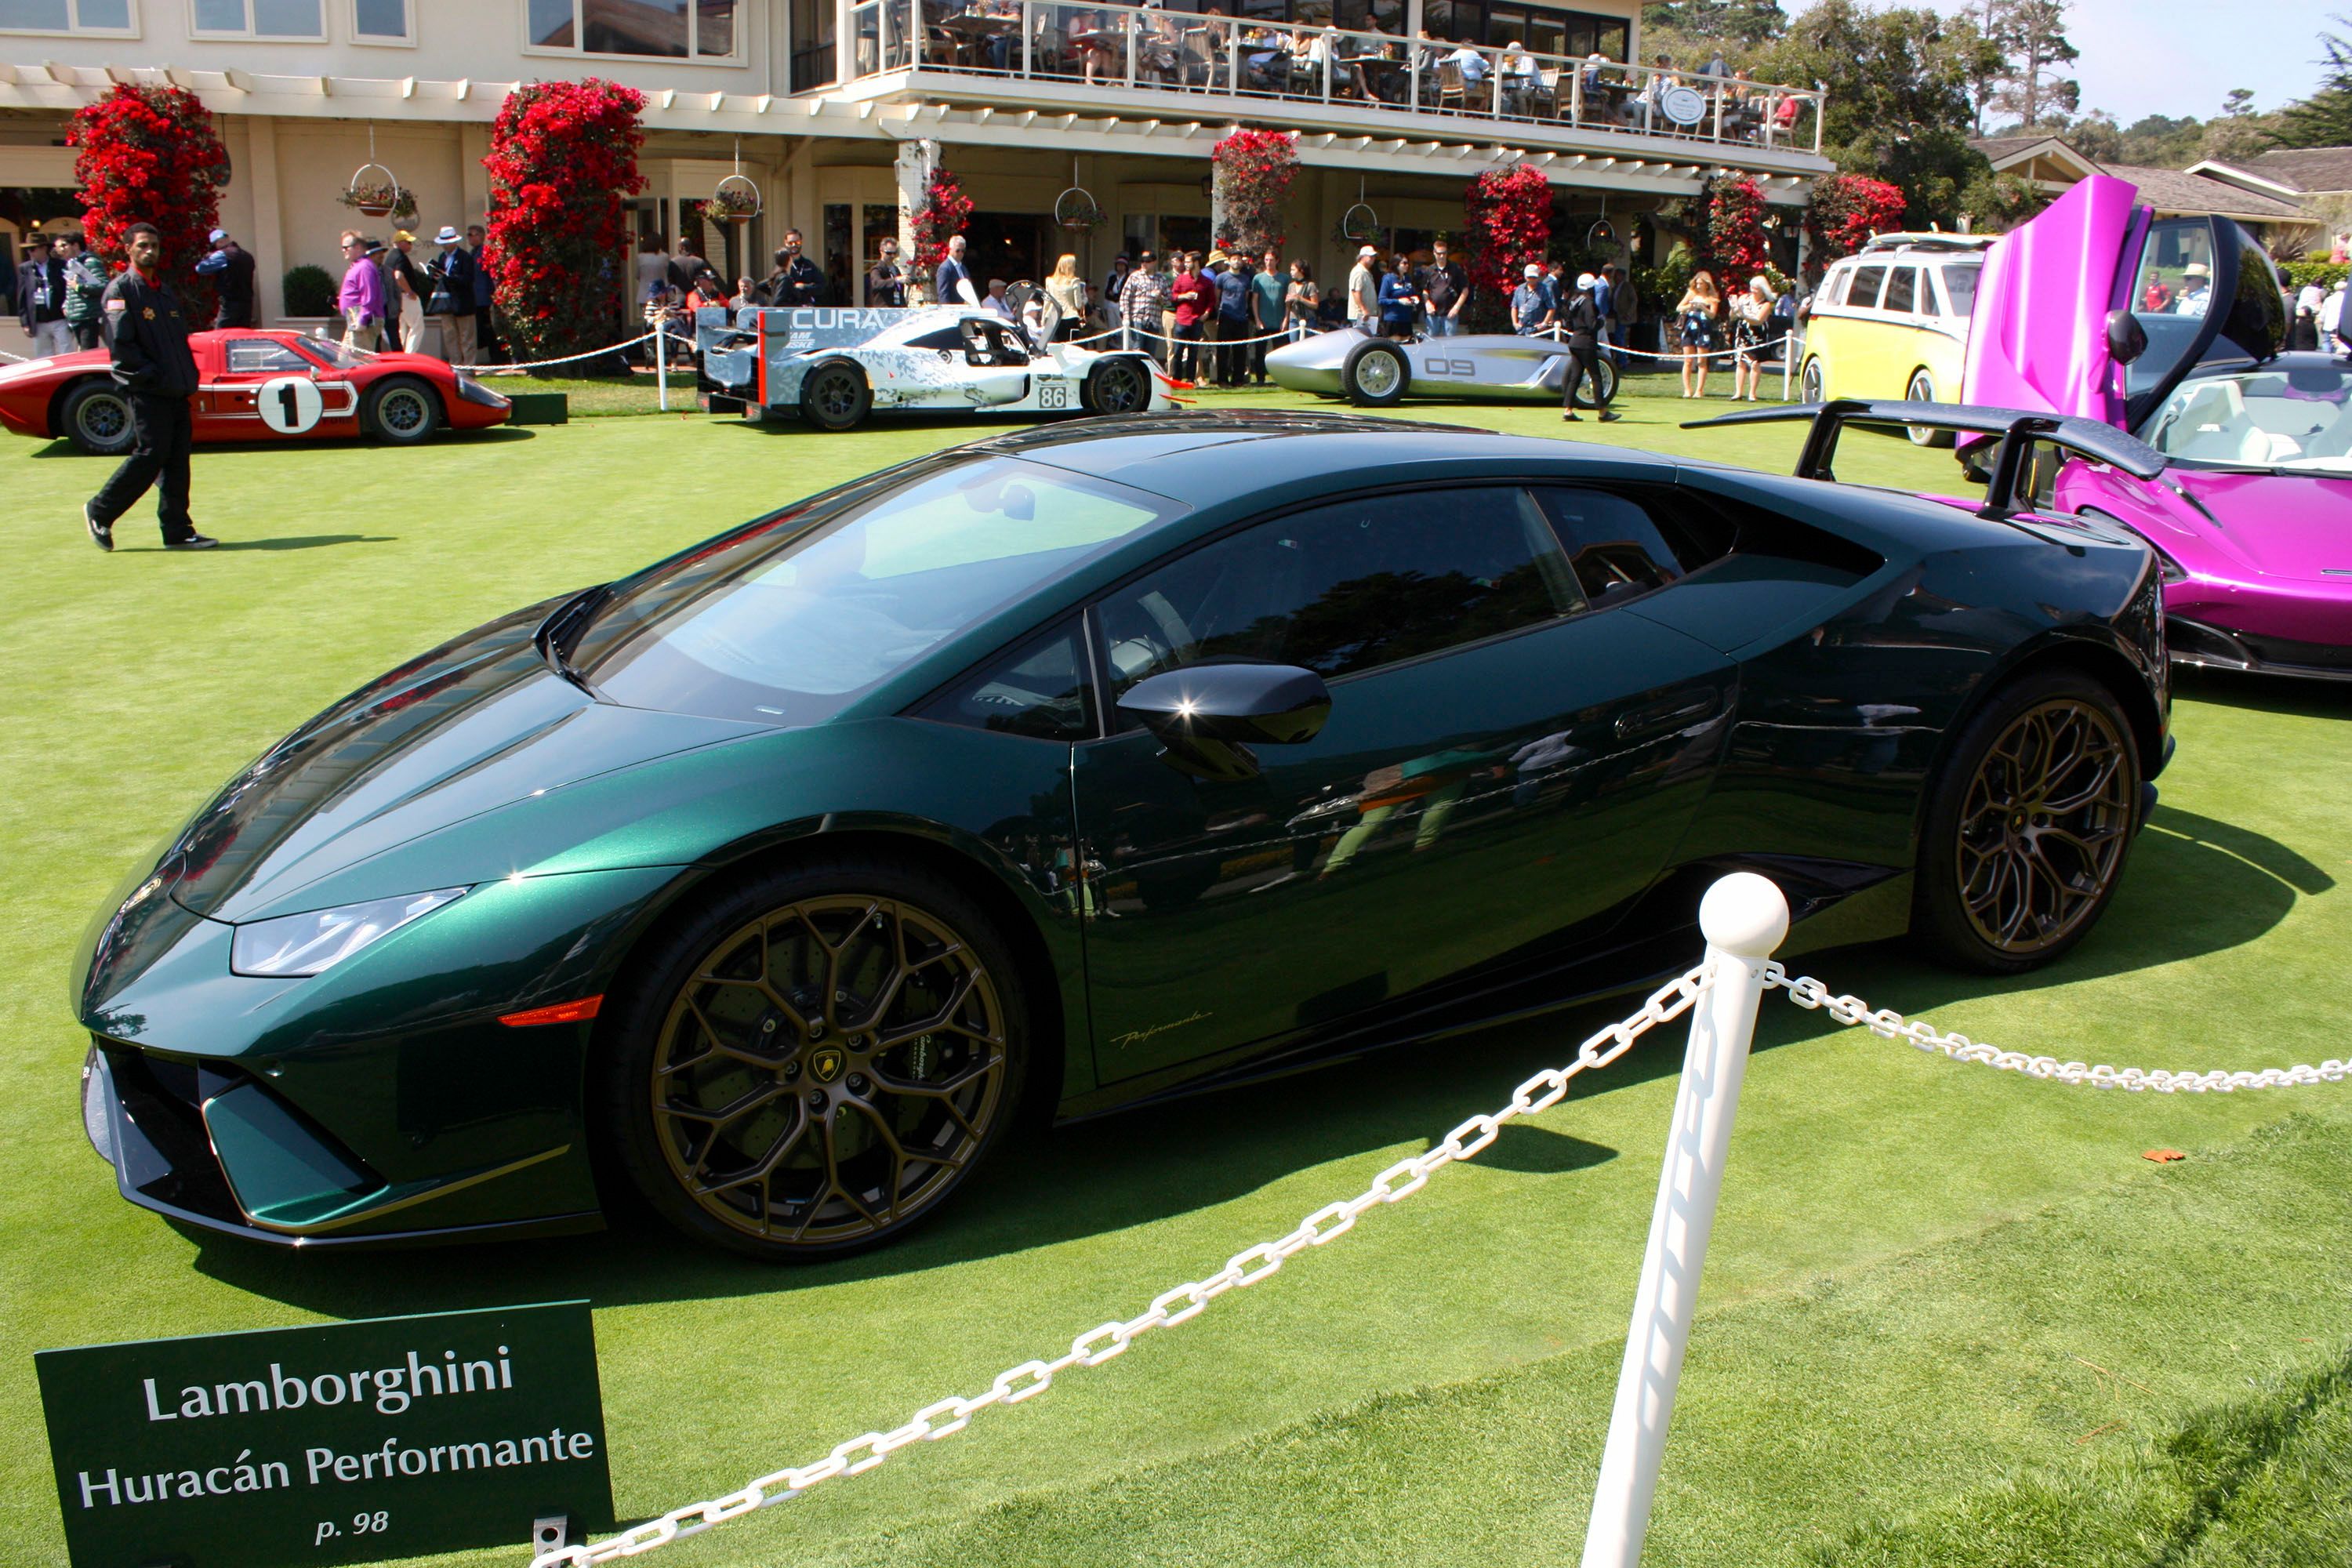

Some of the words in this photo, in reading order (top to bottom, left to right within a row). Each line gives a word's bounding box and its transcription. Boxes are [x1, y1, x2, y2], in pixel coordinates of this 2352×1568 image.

[789, 309, 886, 329] CURA
[1425, 358, 1476, 376] 09
[278, 383, 299, 427] 1
[1041, 387, 1065, 408] 86
[143, 1345, 512, 1420] Lamborghini
[79, 1449, 289, 1508] Huracán
[306, 1428, 593, 1484] Performante
[315, 1521, 343, 1545] p.
[353, 1511, 389, 1534] 98
